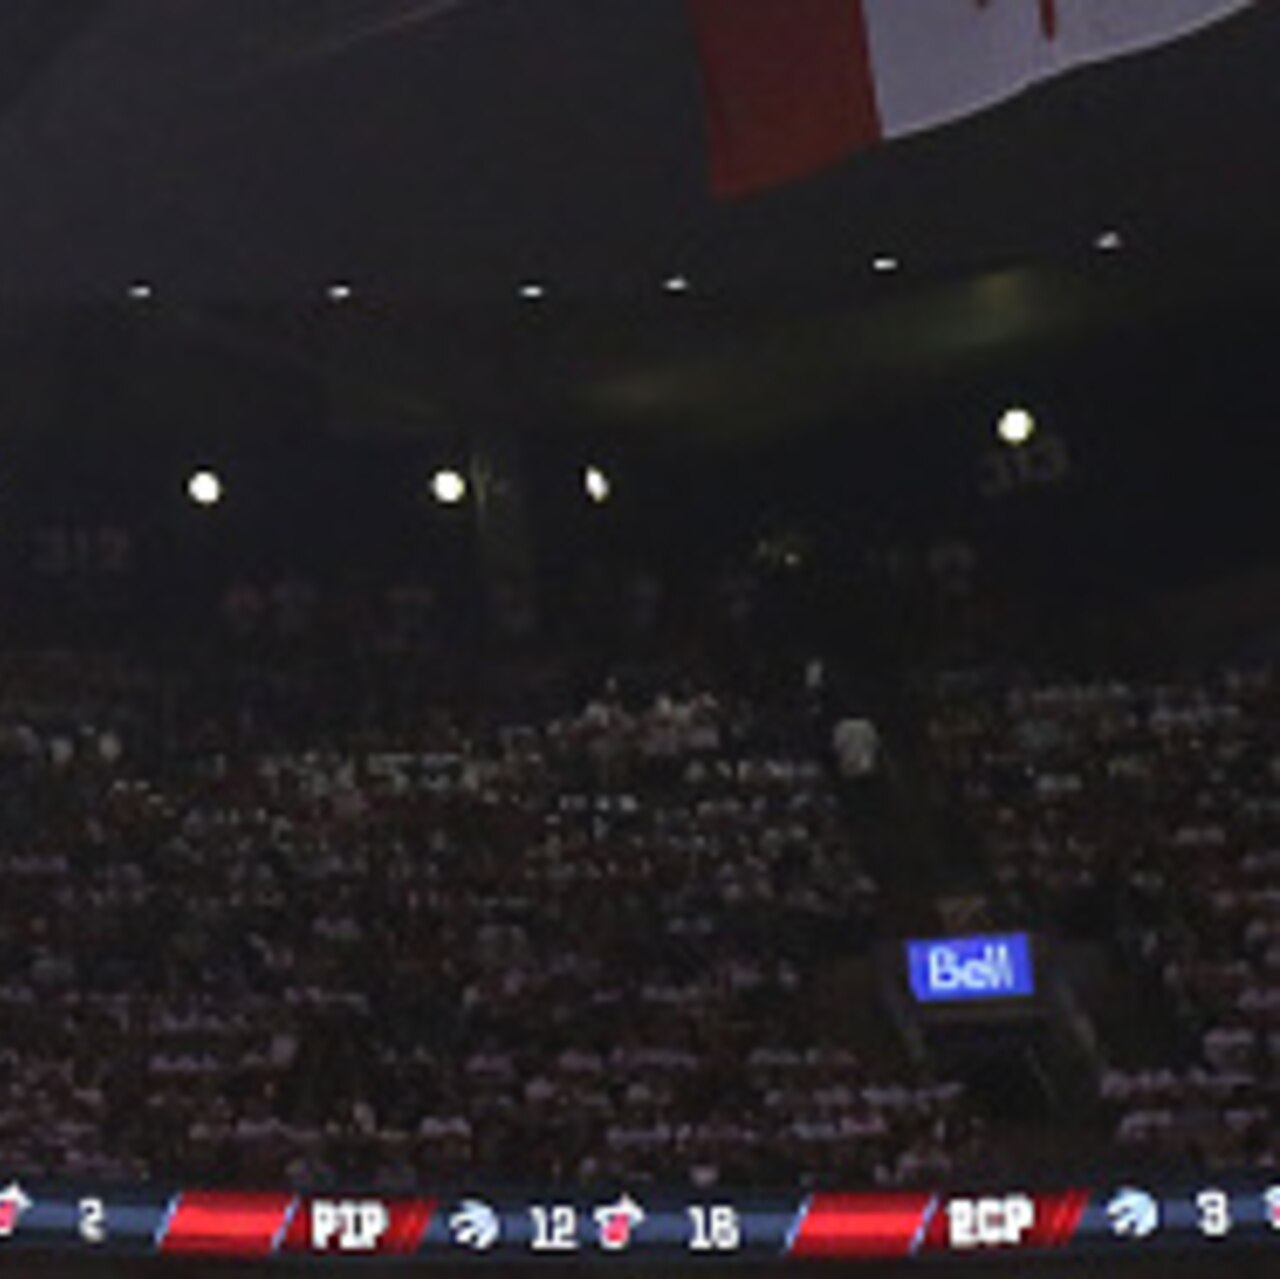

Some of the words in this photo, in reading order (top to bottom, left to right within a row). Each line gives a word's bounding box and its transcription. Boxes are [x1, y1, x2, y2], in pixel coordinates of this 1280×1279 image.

[929, 944, 1014, 990] Bell
[80, 1198, 105, 1241] 2
[311, 1200, 389, 1249] PIP
[531, 1206, 579, 1249] 12
[1197, 1191, 1230, 1236] 3
